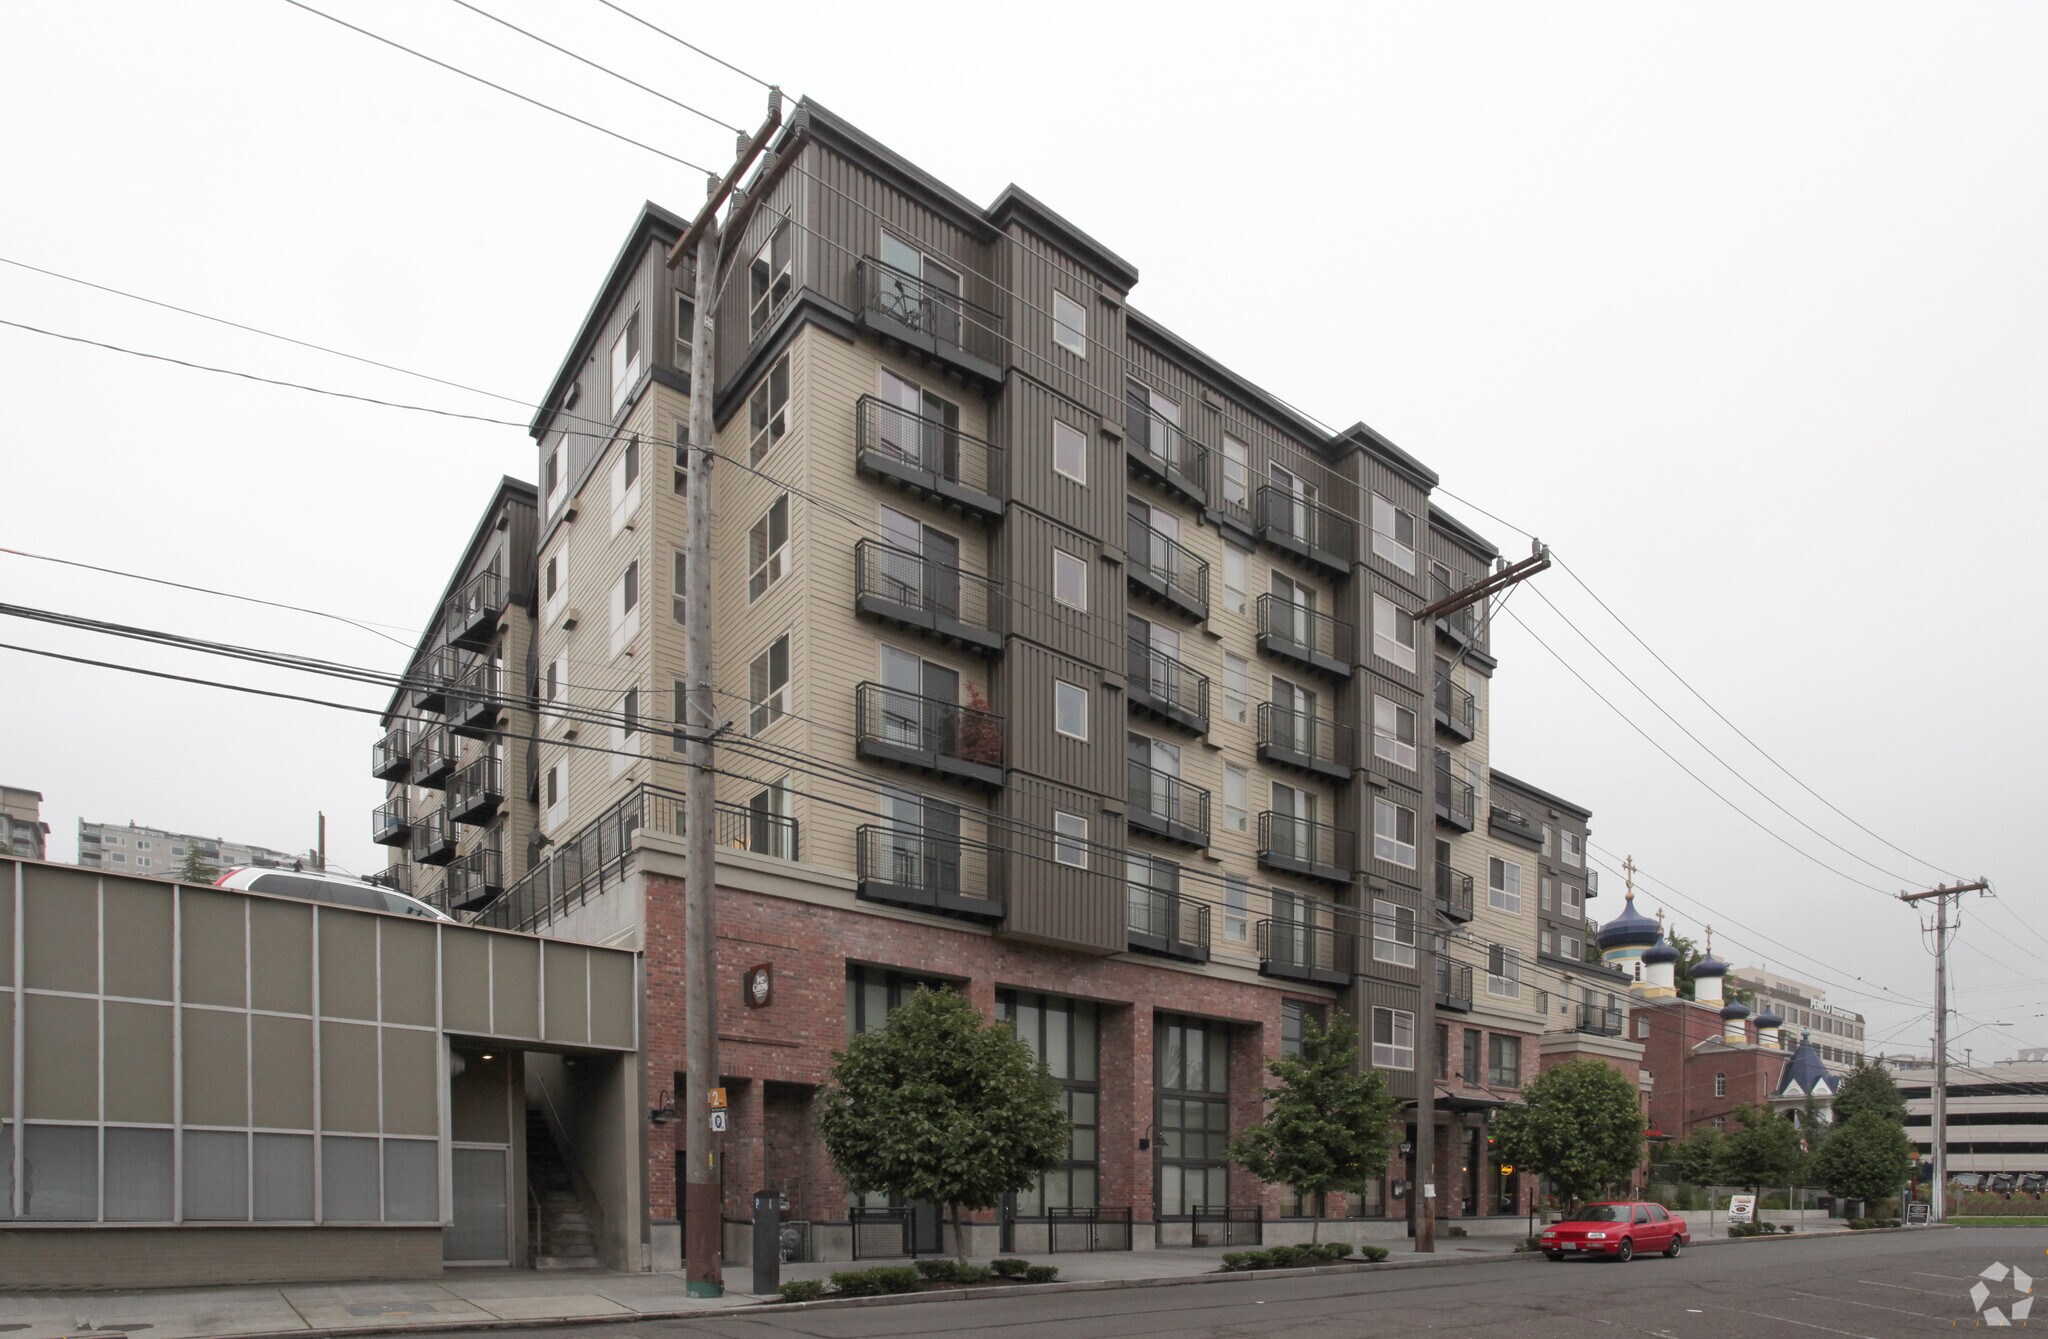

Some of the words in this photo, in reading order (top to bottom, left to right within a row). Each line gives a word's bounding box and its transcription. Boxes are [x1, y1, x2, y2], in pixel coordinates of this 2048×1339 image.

[1810, 998, 1831, 1014] PEMCO
[1831, 1005, 1857, 1021] Insurance
[712, 1090, 720, 1106] 2
[716, 1117, 721, 1127] P
[755, 1198, 760, 1209] P
